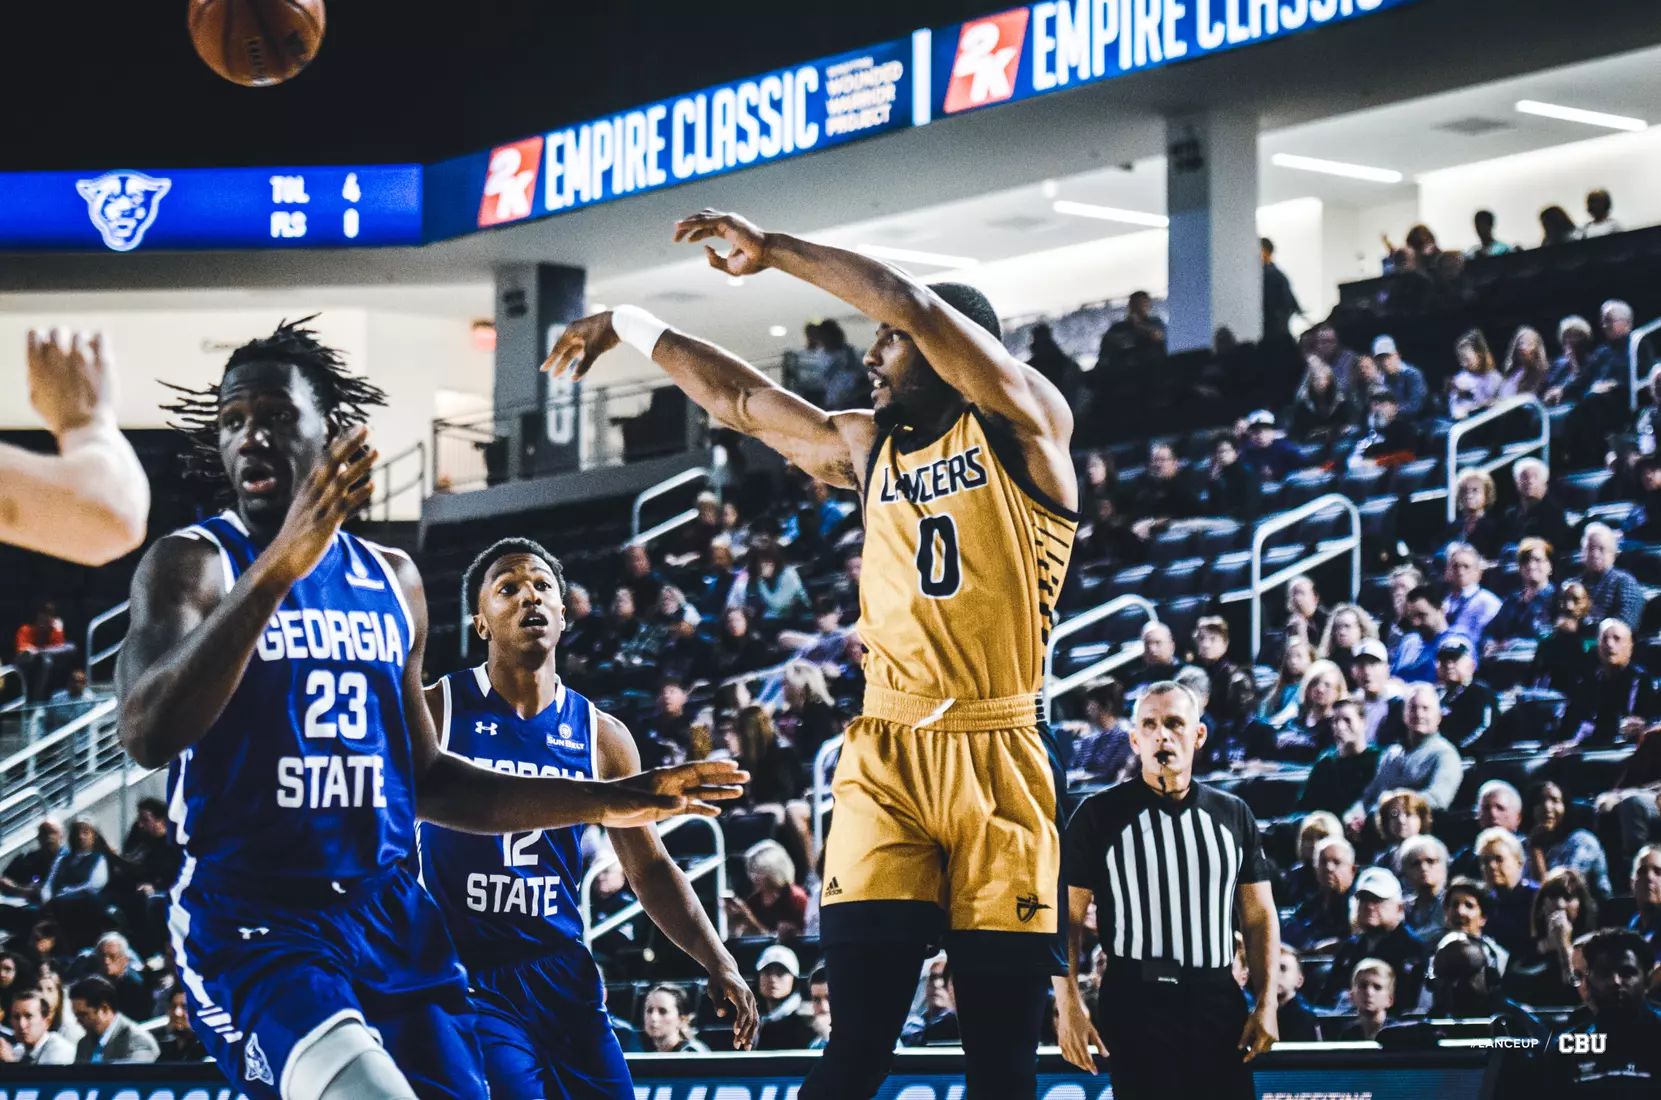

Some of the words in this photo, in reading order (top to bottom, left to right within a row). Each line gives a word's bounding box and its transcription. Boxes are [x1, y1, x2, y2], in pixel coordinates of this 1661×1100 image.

[953, 22, 1016, 101] 2K
[1032, 0, 1187, 91] EMPIRE
[485, 147, 533, 218] 2K
[545, 104, 666, 211] EMPIRE
[672, 66, 819, 179] CLASSIC
[342, 172, 361, 203] 4
[343, 208, 360, 238] 0
[880, 444, 988, 503] LANCERS
[914, 511, 962, 599] 0
[257, 608, 403, 667] GEORGIA
[304, 669, 368, 740] 23
[546, 733, 565, 747] SUN
[276, 755, 387, 810] STATE
[466, 872, 561, 917] STATE
